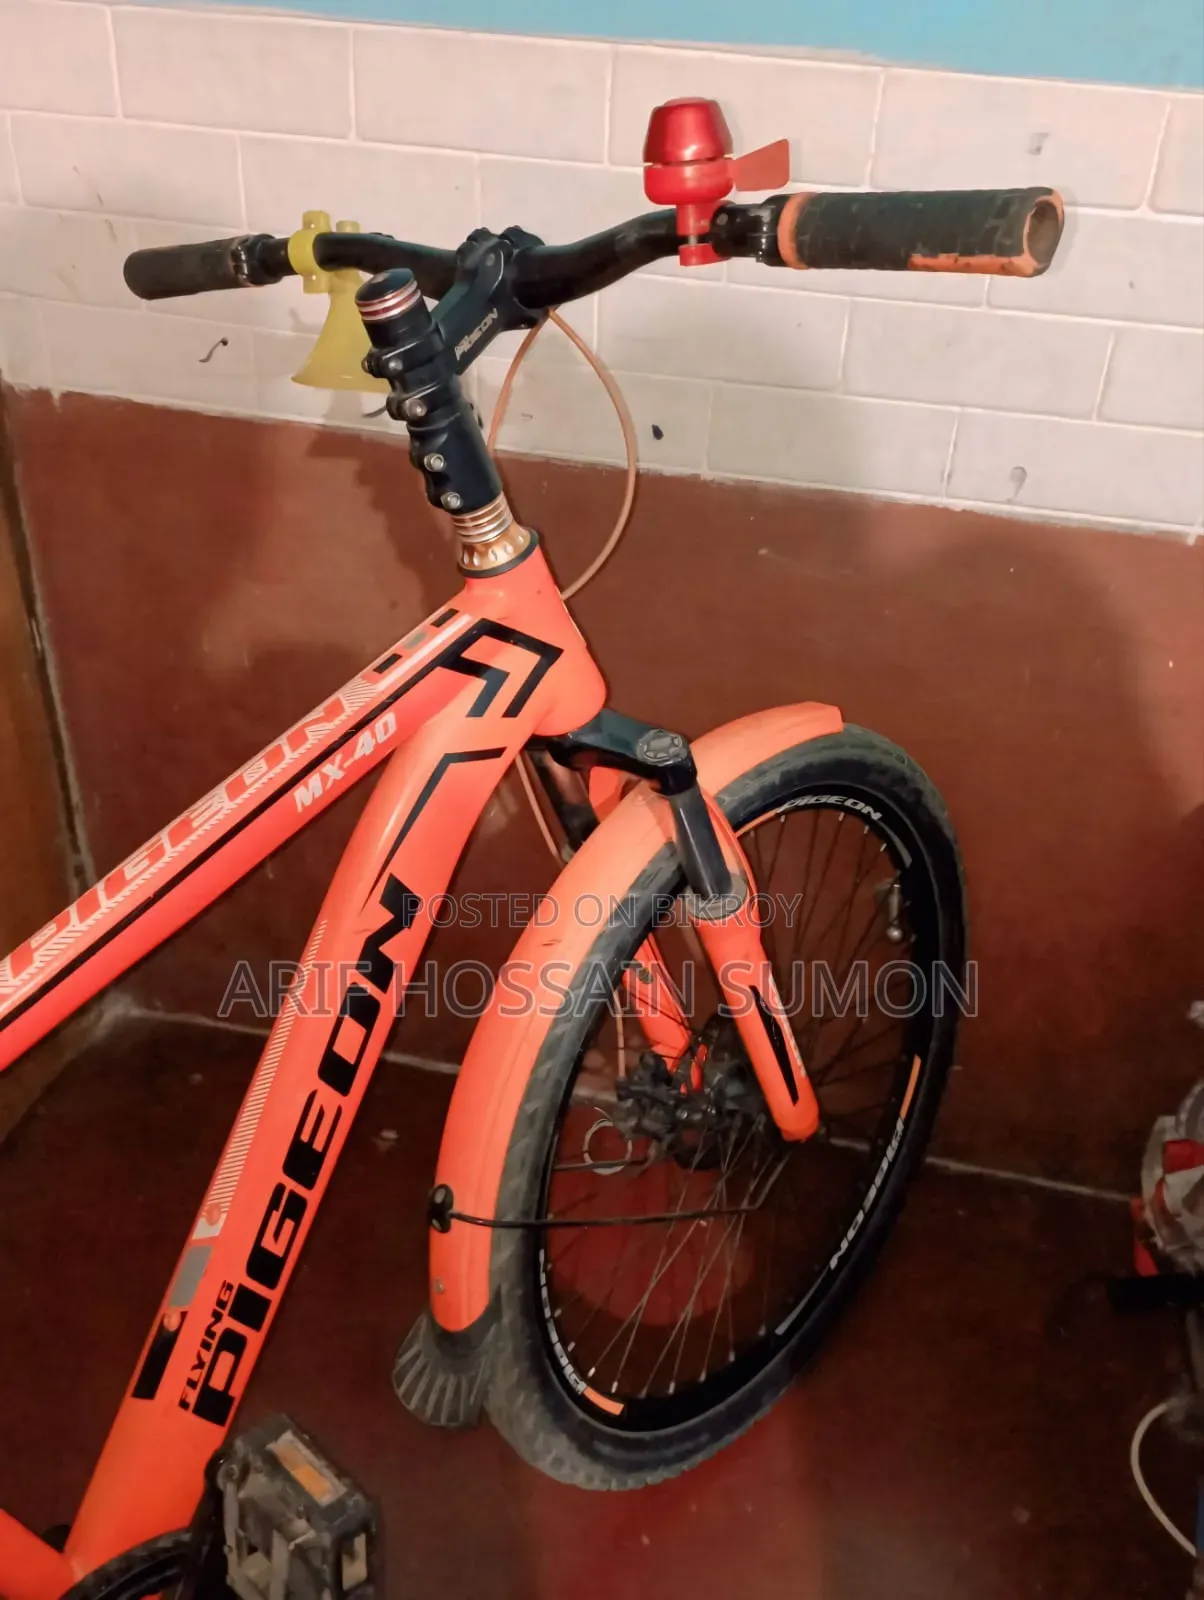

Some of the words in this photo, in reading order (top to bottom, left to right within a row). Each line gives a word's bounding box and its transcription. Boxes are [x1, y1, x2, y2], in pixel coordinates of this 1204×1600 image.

[293, 710, 398, 812] MX-40
[777, 794, 882, 820] PIGEON
[8, 694, 350, 979] PIGEON
[192, 873, 421, 1427] PIGEON
[179, 1280, 235, 1411] FLYING
